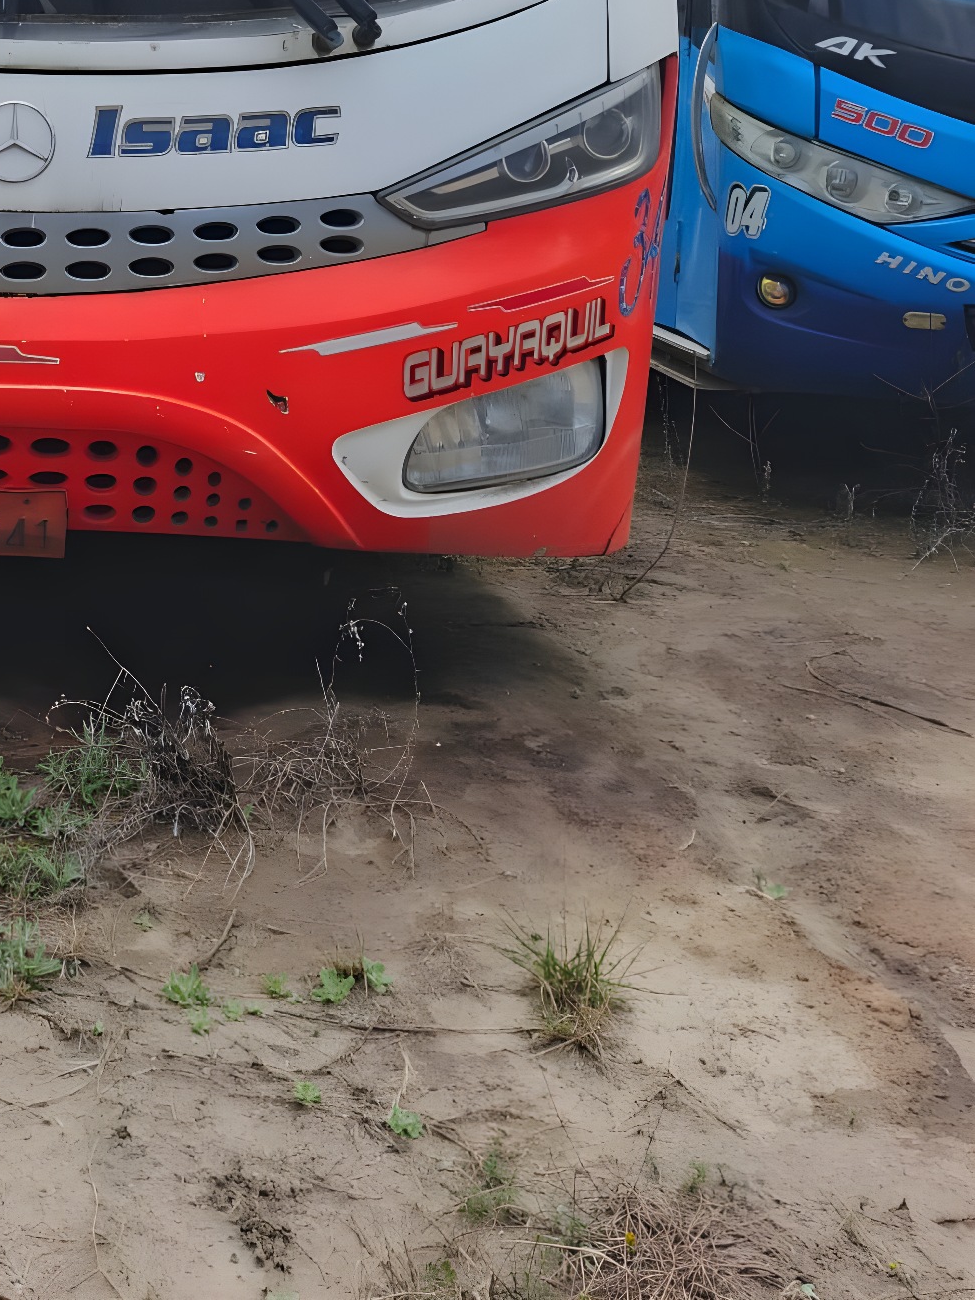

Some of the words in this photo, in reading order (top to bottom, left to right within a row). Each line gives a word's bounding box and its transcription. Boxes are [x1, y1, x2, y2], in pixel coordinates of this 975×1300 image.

[86, 104, 342, 159] Isaac
[831, 98, 935, 149] 500
[725, 181, 772, 240] 04
[874, 251, 971, 293] HINO
[403, 297, 615, 402] GUAYAQUIL
